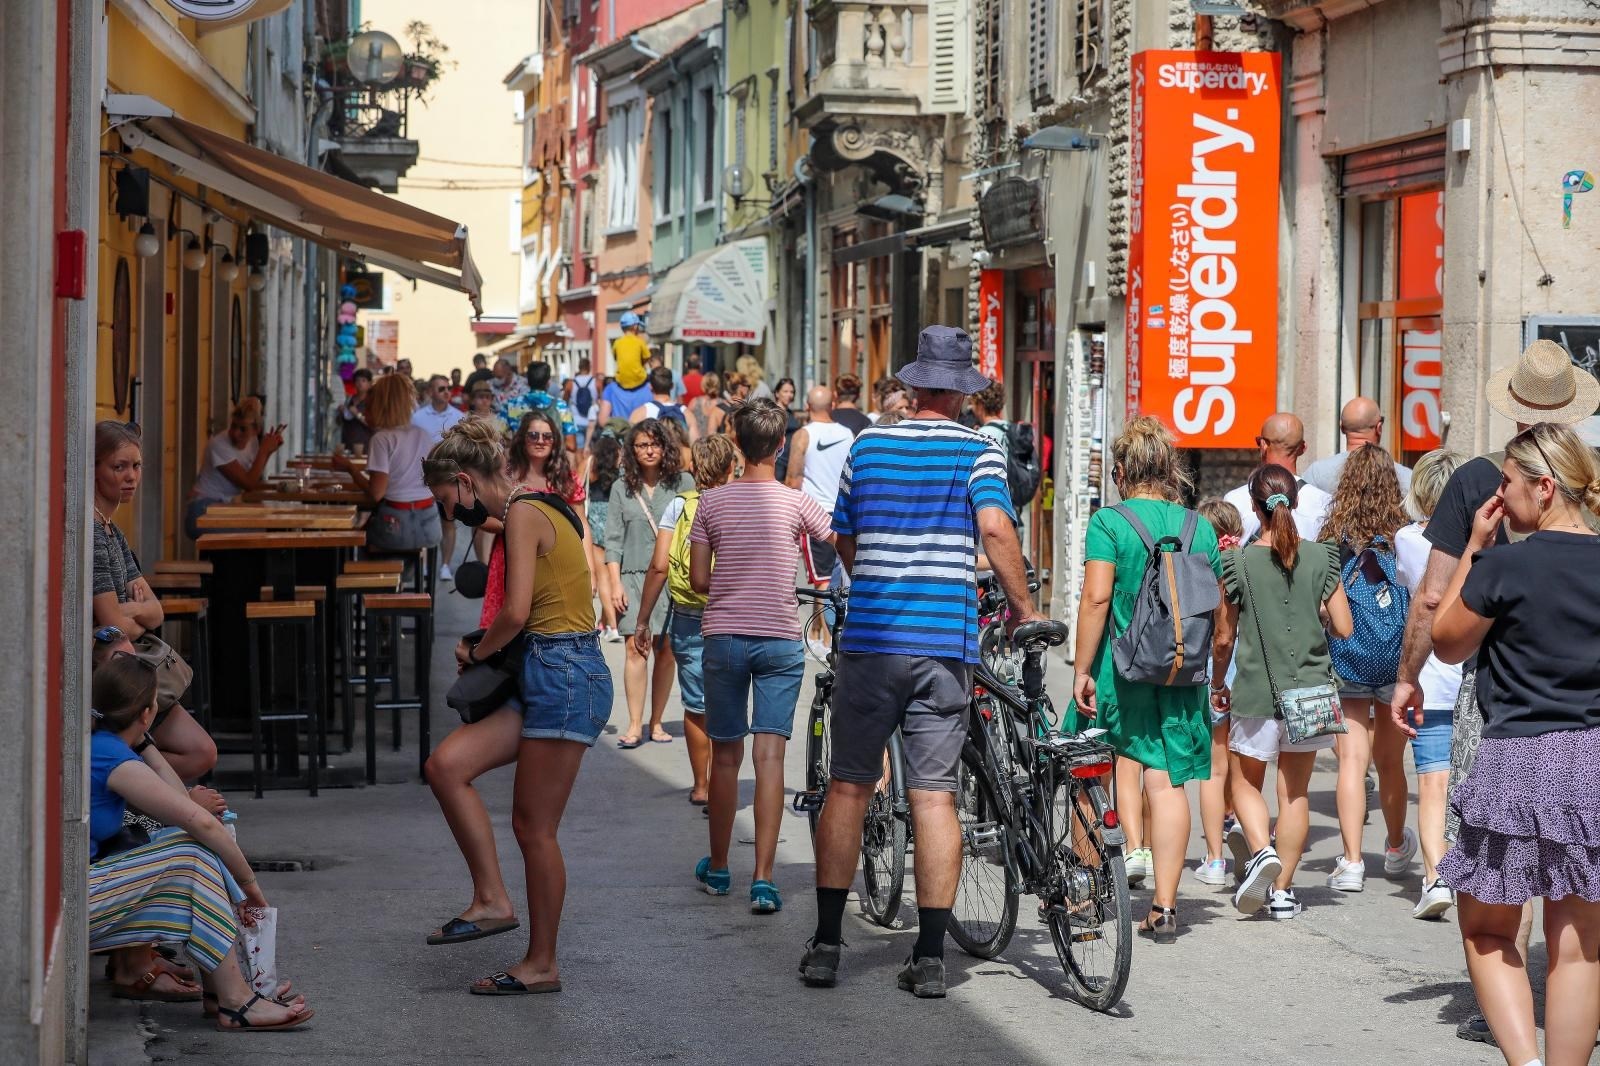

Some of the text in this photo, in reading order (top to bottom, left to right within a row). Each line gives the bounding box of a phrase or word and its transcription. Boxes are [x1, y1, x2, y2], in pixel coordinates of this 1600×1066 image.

[1158, 63, 1268, 96] Superdry.
[1168, 203, 1190, 379] 極度乾燥(しなさい)
[1172, 108, 1255, 436] Superdry.
